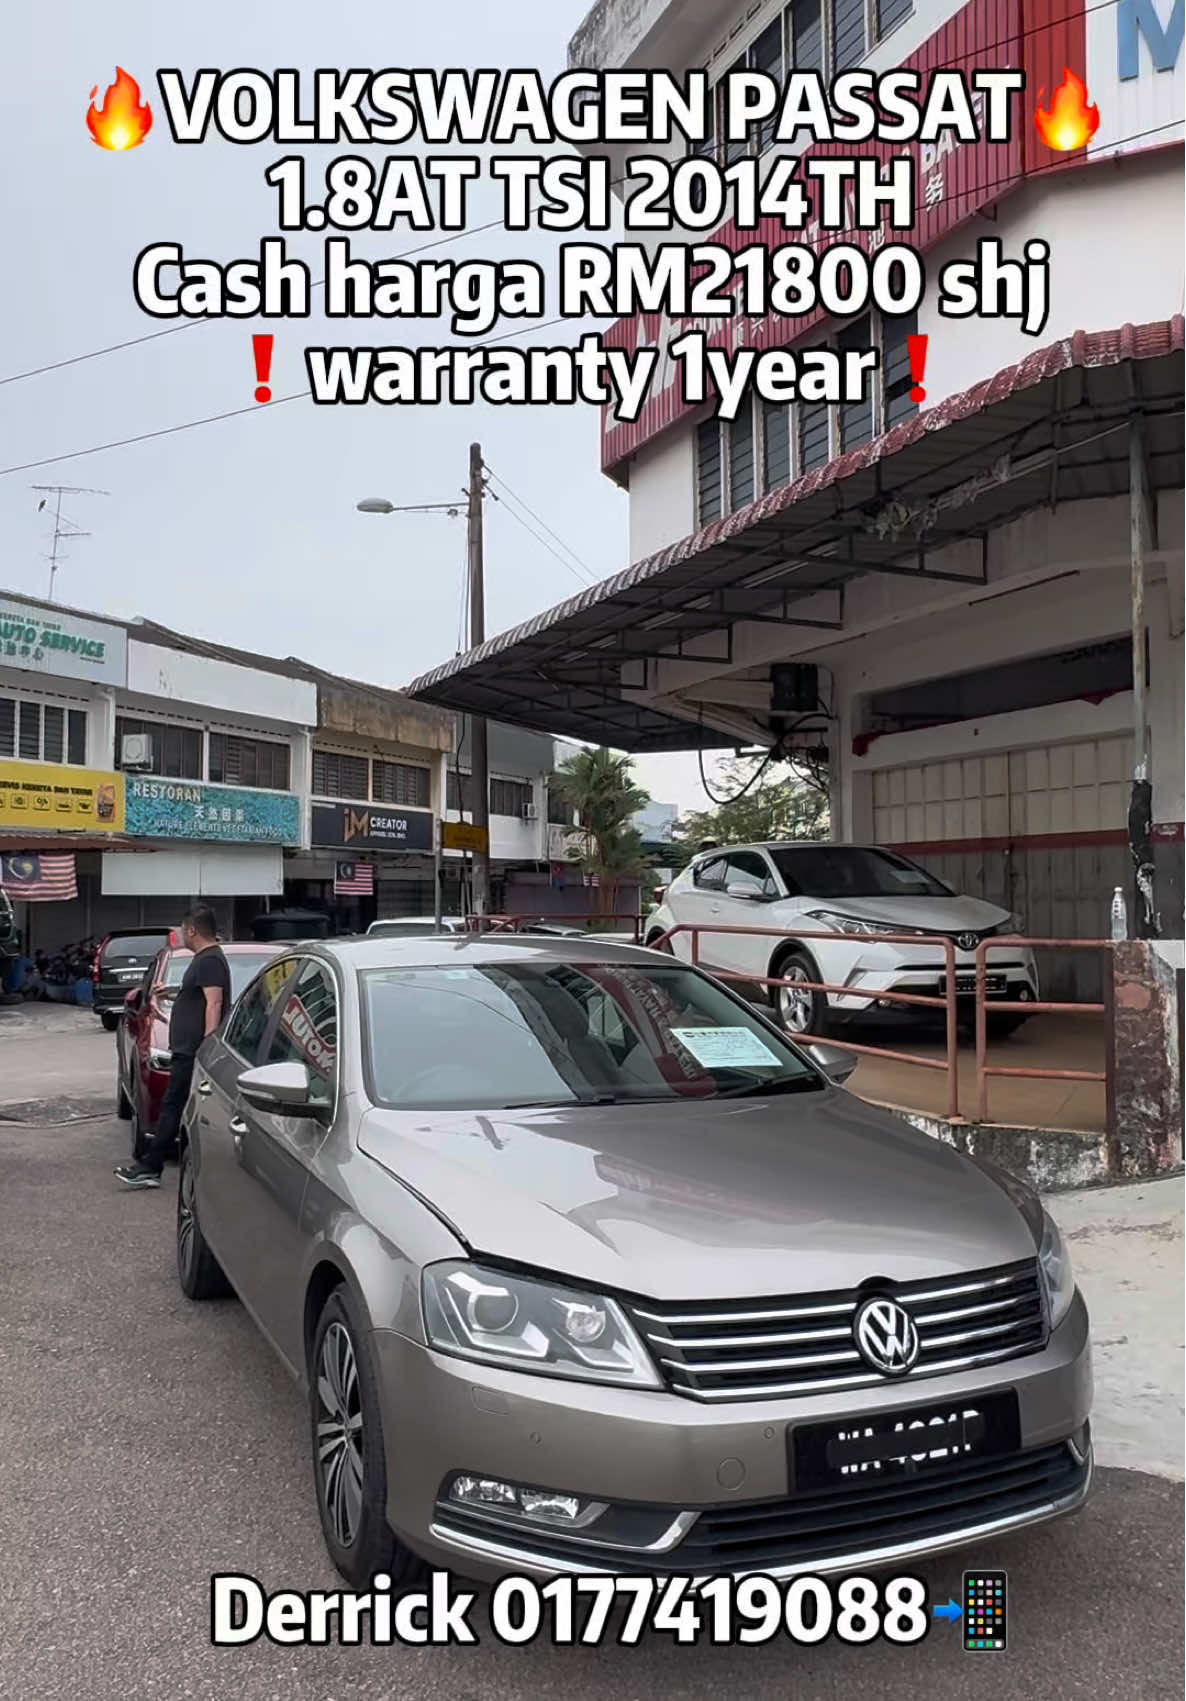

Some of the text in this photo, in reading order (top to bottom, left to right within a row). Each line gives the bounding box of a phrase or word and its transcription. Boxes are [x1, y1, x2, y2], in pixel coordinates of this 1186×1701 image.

[40, 630, 105, 658] SERVICE
[133, 782, 200, 802] RESTORAN
[370, 816, 407, 831] CREATOR
